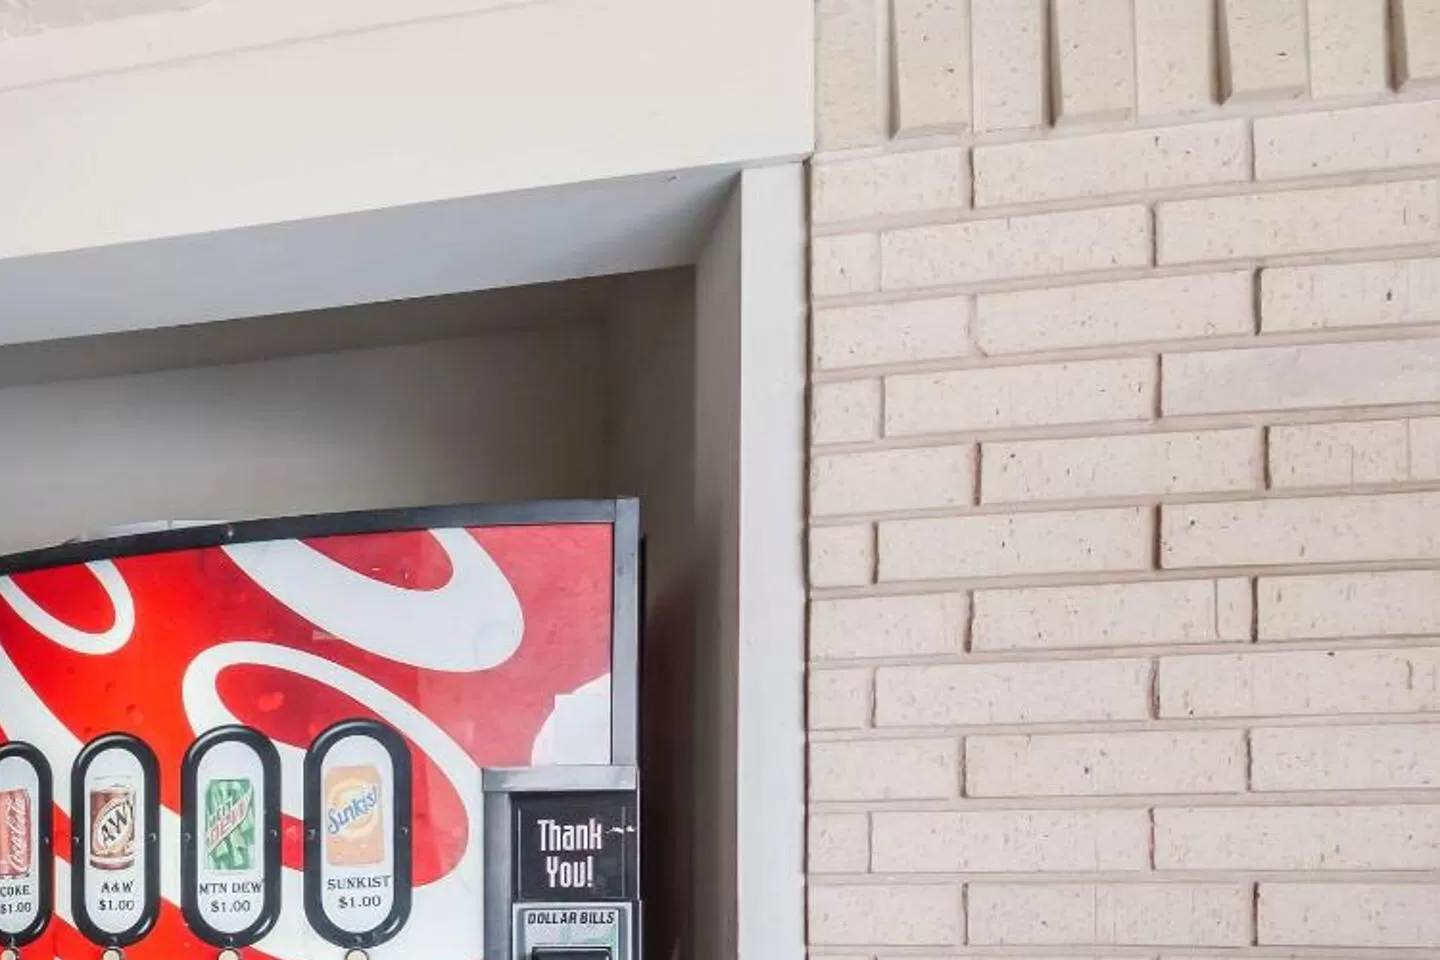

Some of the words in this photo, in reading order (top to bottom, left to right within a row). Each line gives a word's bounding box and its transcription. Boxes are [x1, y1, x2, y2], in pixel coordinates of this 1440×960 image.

[537, 818, 602, 851] Thank
[546, 855, 594, 888] You!
[101, 879, 133, 893] A&W
[199, 881, 228, 895] MTN
[231, 880, 262, 894] DEW
[327, 875, 391, 890] SUNKIST
[0, 885, 31, 897] COKE
[0, 901, 31, 914] $1.00
[98, 899, 135, 911] $1.00
[210, 900, 251, 913] $1.00
[338, 895, 381, 909] $1.00
[527, 911, 577, 925] DOLLAR
[580, 911, 615, 926] BILLS
